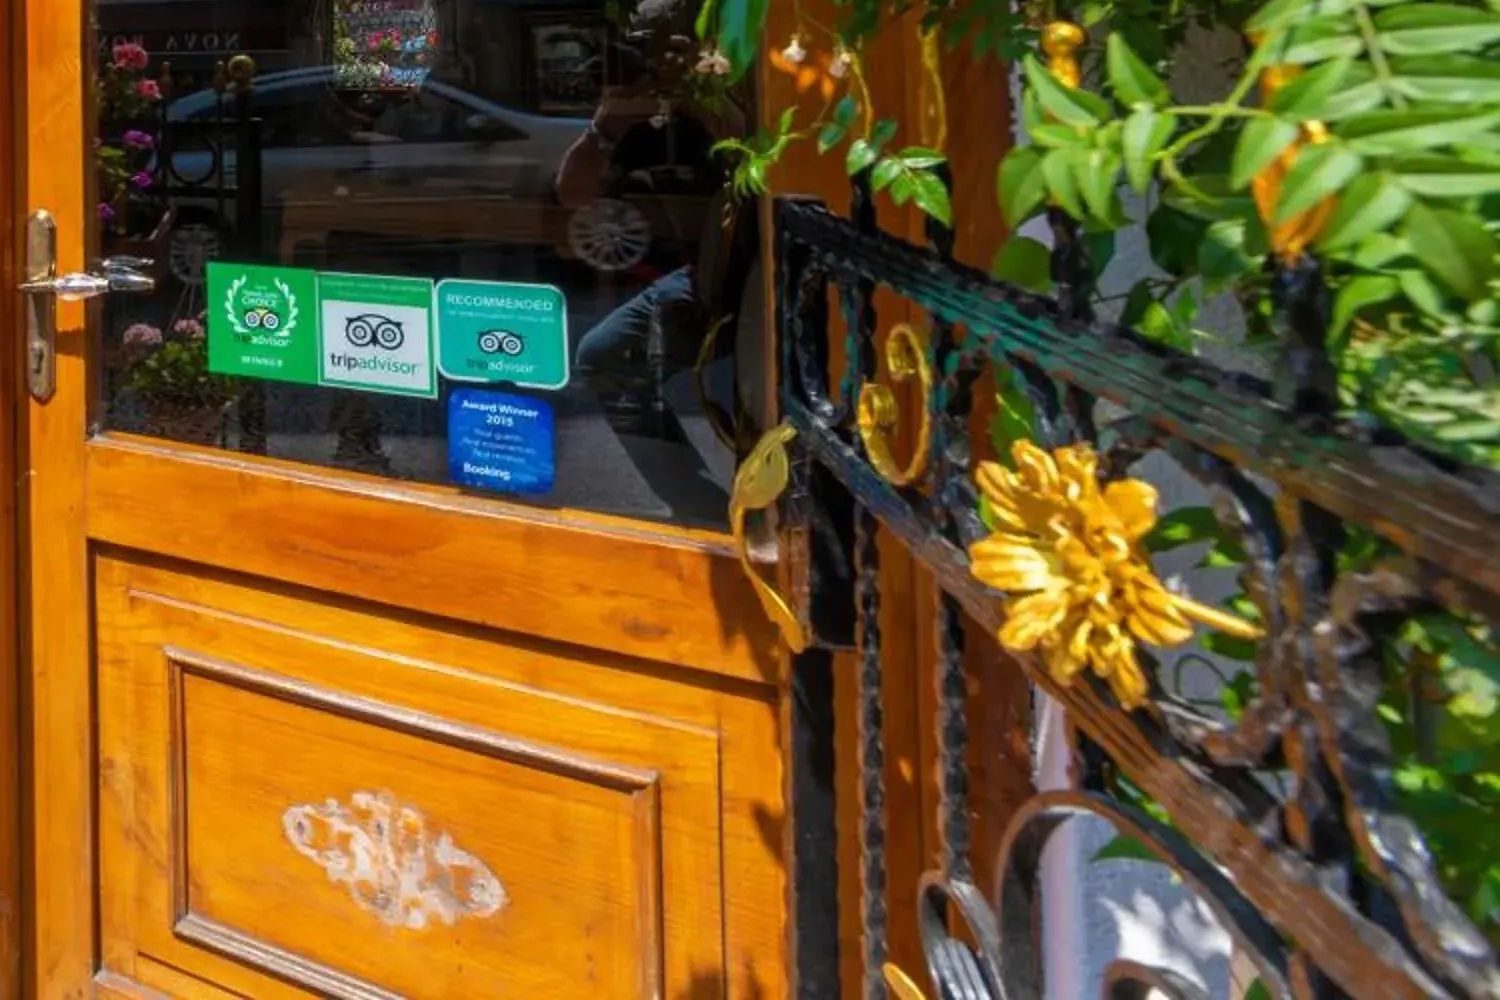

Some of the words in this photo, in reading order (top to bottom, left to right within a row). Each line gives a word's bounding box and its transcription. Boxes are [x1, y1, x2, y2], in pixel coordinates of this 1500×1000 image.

[446, 294, 553, 311] RECOMMENDED
[330, 352, 419, 375] tripadvisor
[462, 400, 497, 413] Award
[499, 404, 538, 418] Winner
